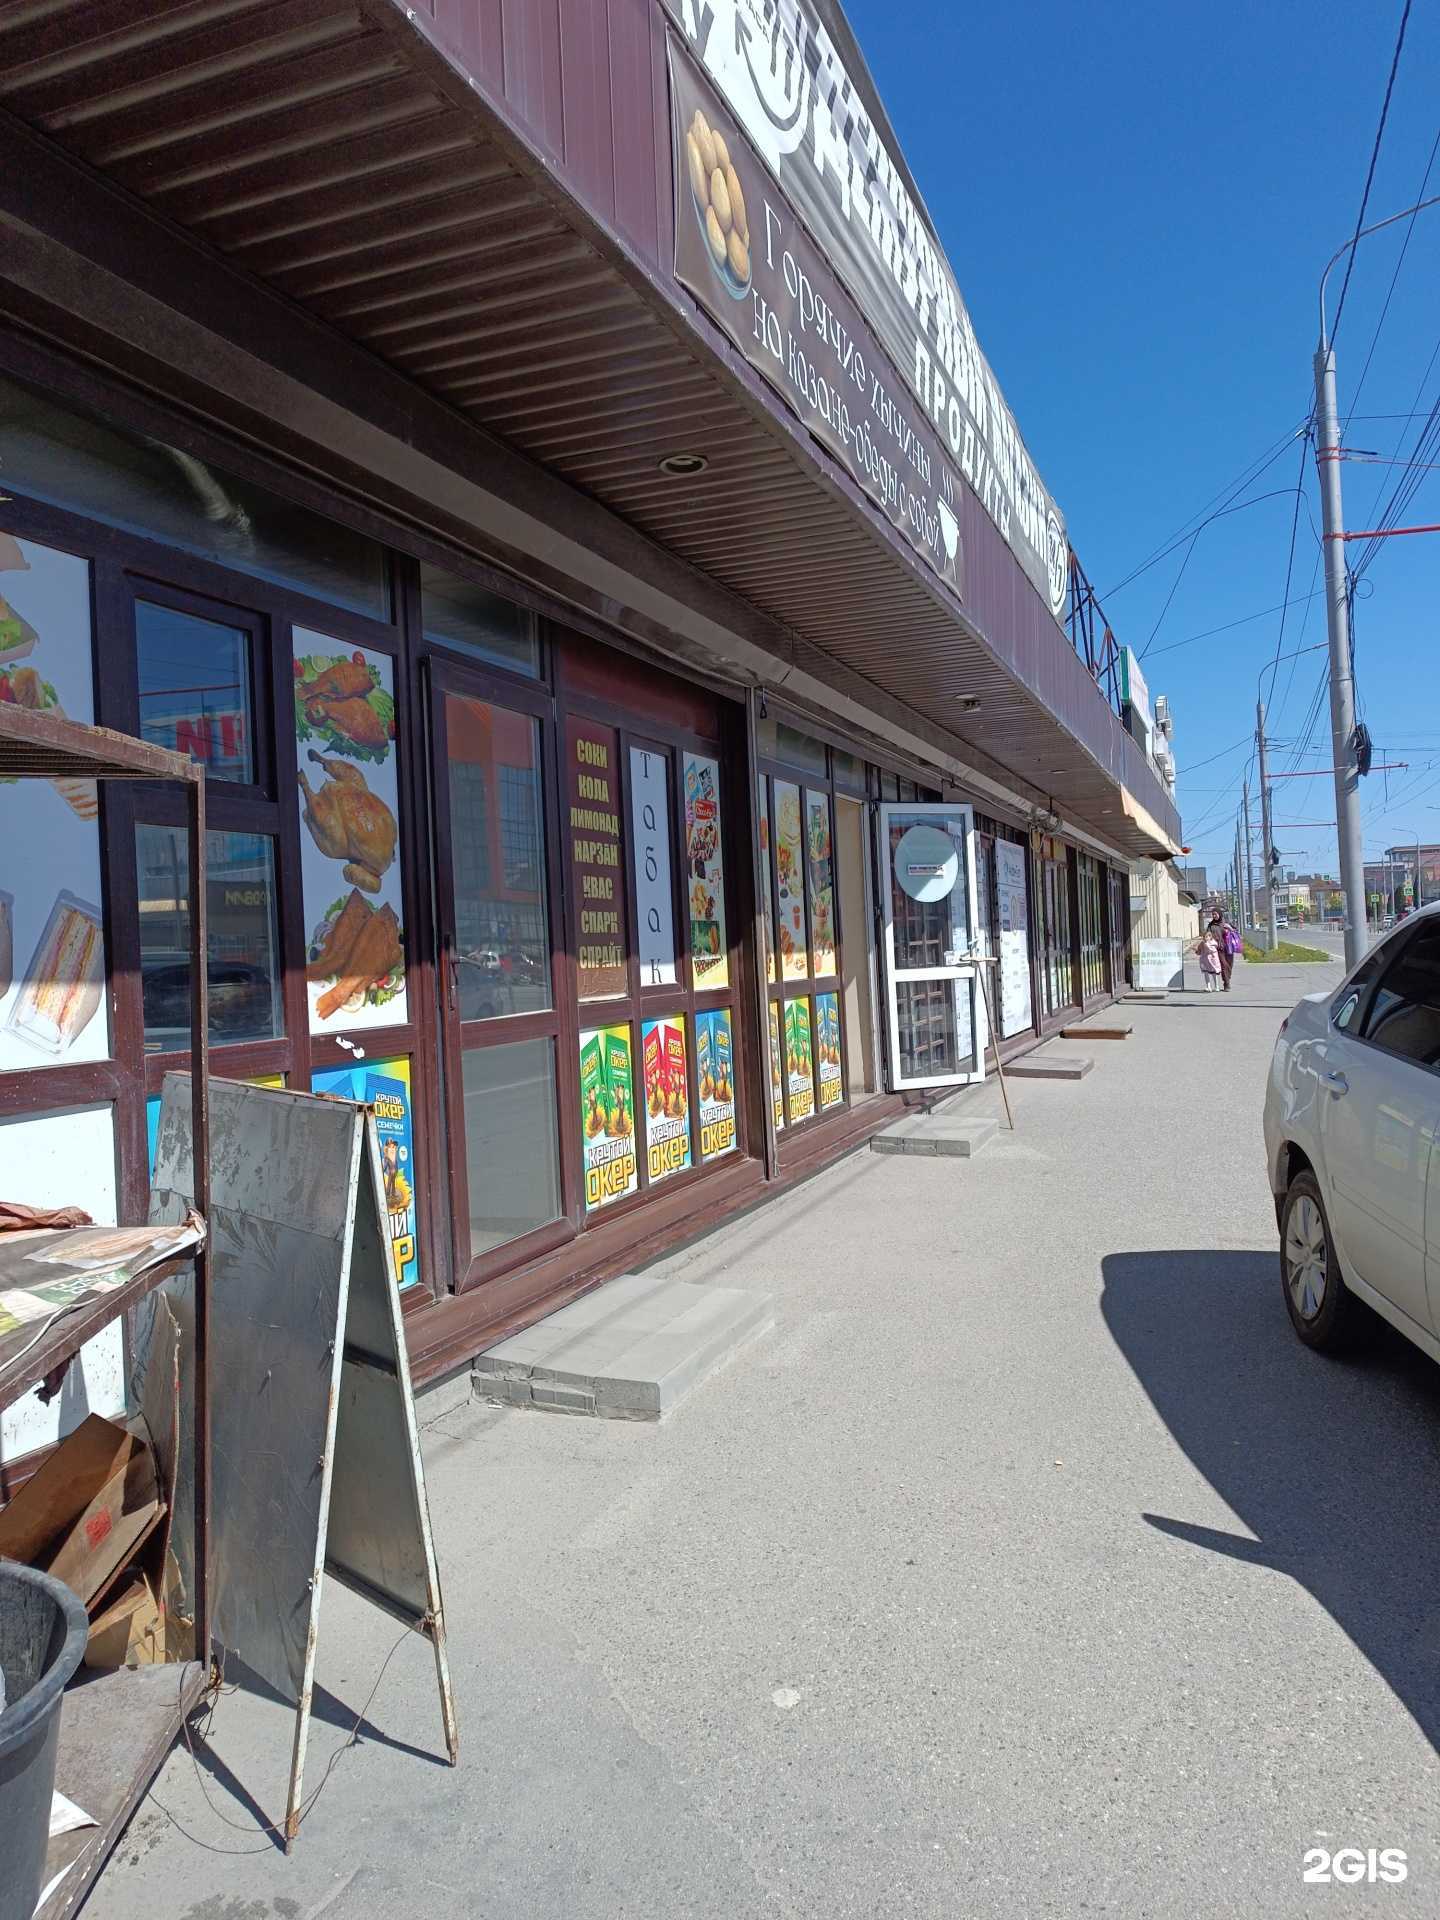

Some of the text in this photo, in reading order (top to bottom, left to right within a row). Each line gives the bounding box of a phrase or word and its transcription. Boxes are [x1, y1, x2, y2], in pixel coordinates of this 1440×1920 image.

[764, 199, 932, 490] Горячие хычины
[752, 288, 940, 556] на казане-обеды с собой
[915, 336, 1011, 541] ПРОДУКТЫ
[576, 739, 608, 769] СОКИ
[578, 775, 609, 803] КОЛА
[570, 807, 619, 836] ЛИМОНАД
[574, 839, 618, 866] НАРЗАН
[640, 752, 662, 984] Табак
[583, 876, 613, 900] КВАС
[581, 910, 618, 934] СПАРК
[579, 942, 624, 969] СПРАЙТ
[374, 1101, 405, 1120] ОКЕР
[375, 1092, 402, 1105] КРУТОЙ
[700, 1103, 733, 1126] КРУТОЙ
[650, 1119, 685, 1145] КРУТОЙ
[700, 1118, 736, 1155] ОКЕР
[589, 1136, 633, 1168] КРУТОЙ
[649, 1135, 689, 1178] ОКЕР
[586, 1154, 634, 1205] ОКЕР
